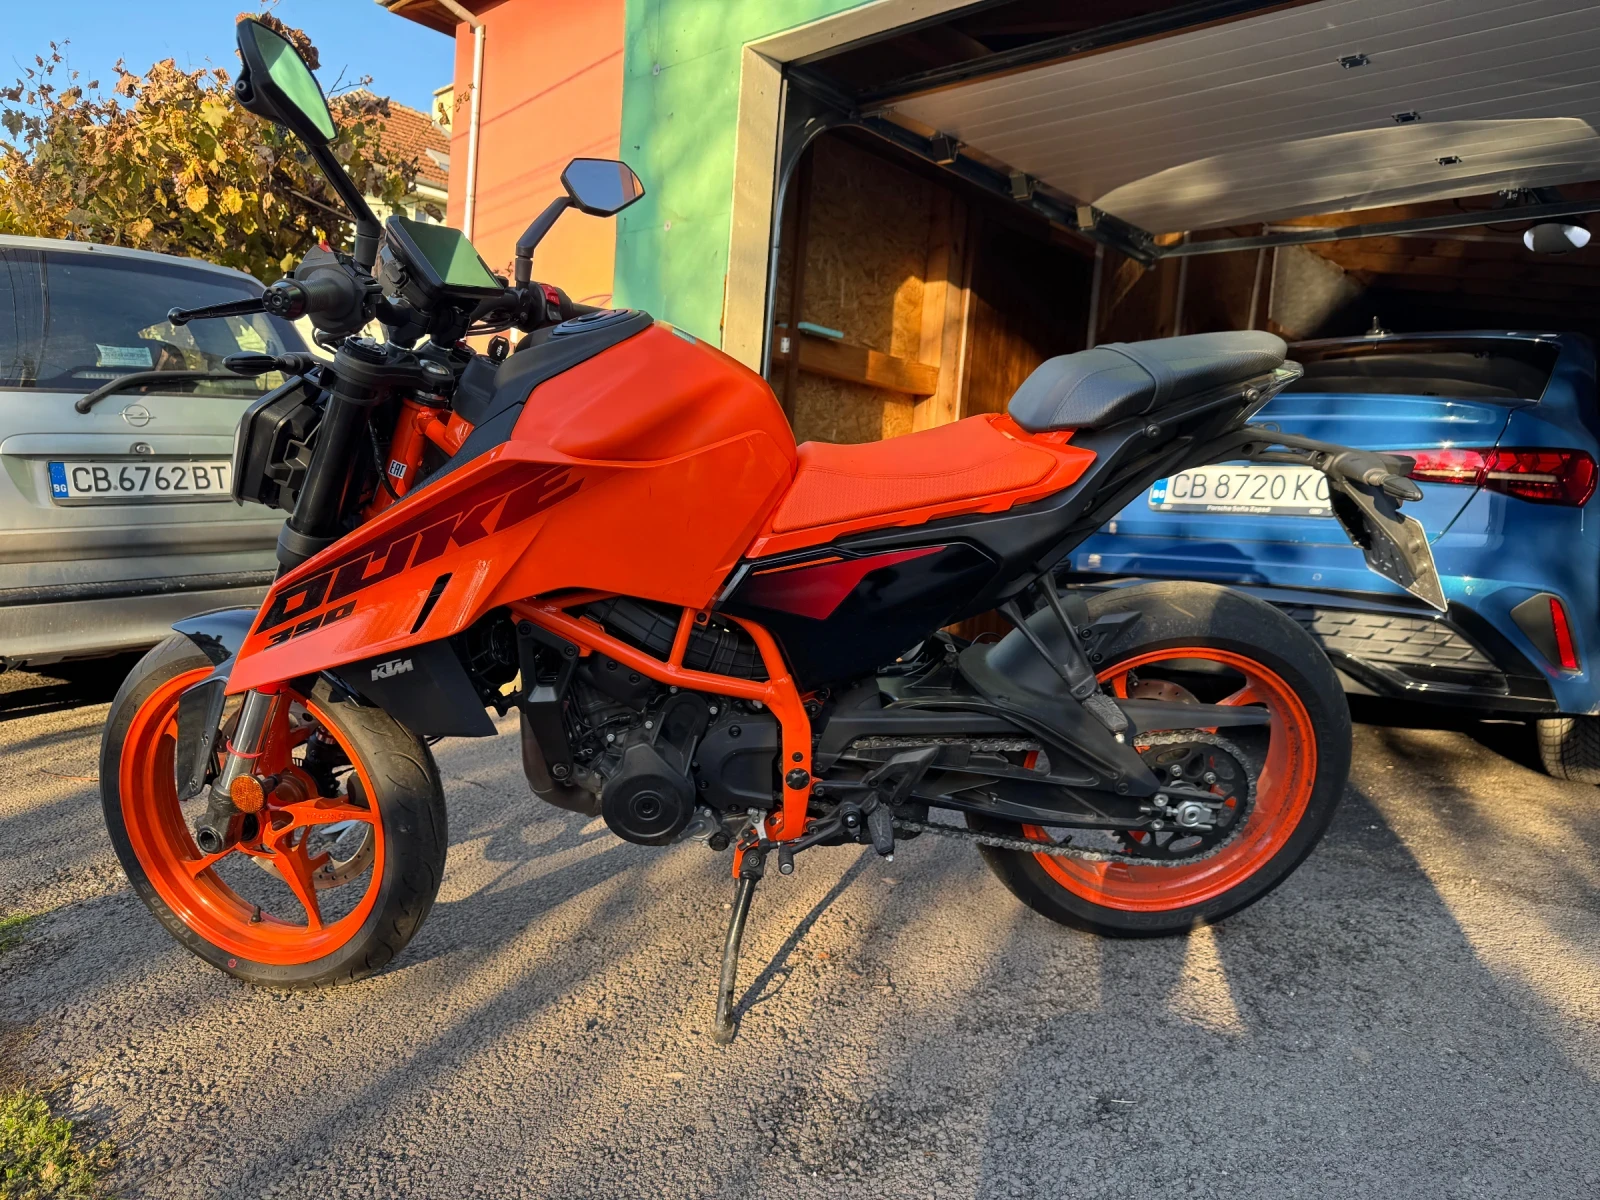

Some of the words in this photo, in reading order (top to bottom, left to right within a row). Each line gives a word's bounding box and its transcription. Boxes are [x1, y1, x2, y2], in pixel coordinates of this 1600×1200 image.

[54, 484, 67, 493] BG
[1214, 474, 1286, 500] 8720
[254, 464, 586, 636] DUKE
[264, 600, 357, 651] 390
[371, 658, 414, 682] KTM
